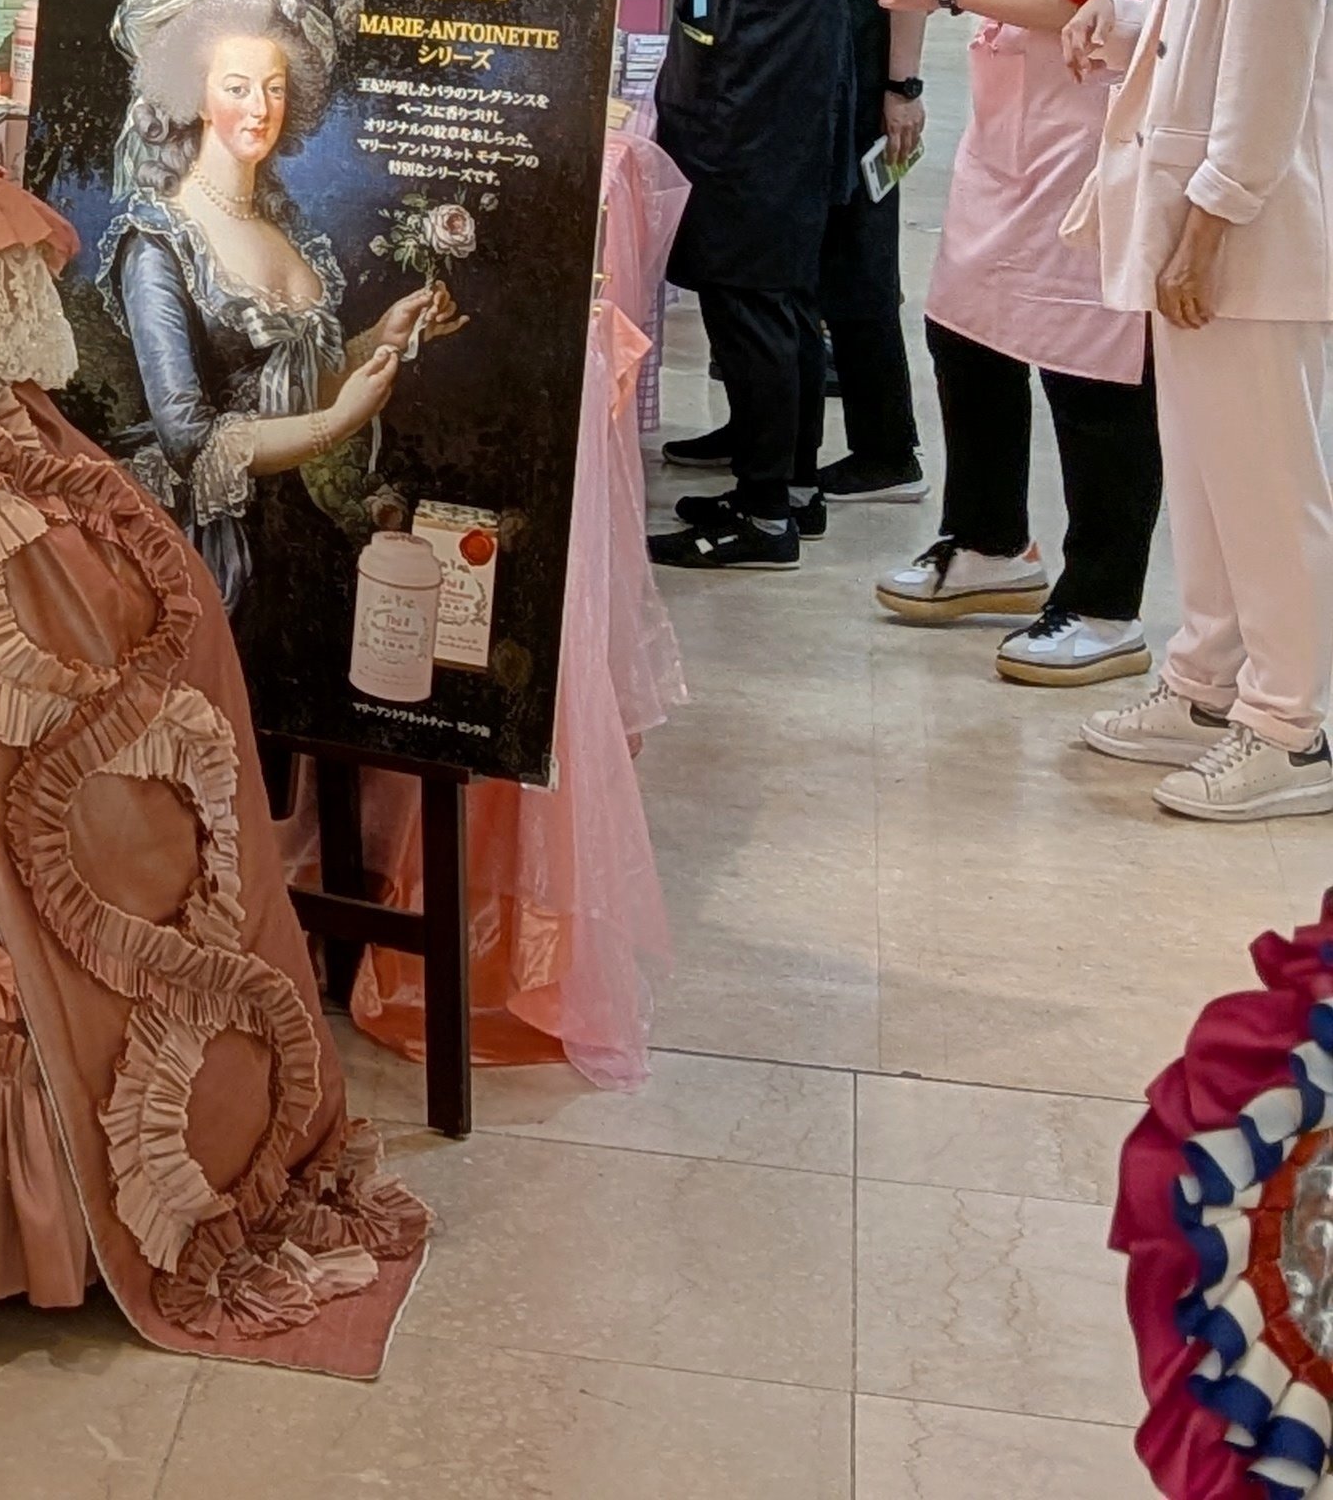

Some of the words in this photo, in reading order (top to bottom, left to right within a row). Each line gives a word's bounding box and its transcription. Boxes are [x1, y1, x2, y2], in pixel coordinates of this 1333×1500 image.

[358, 13, 560, 49] MARIE-ANTOINETTE
[418, 44, 495, 71] シリーズ
